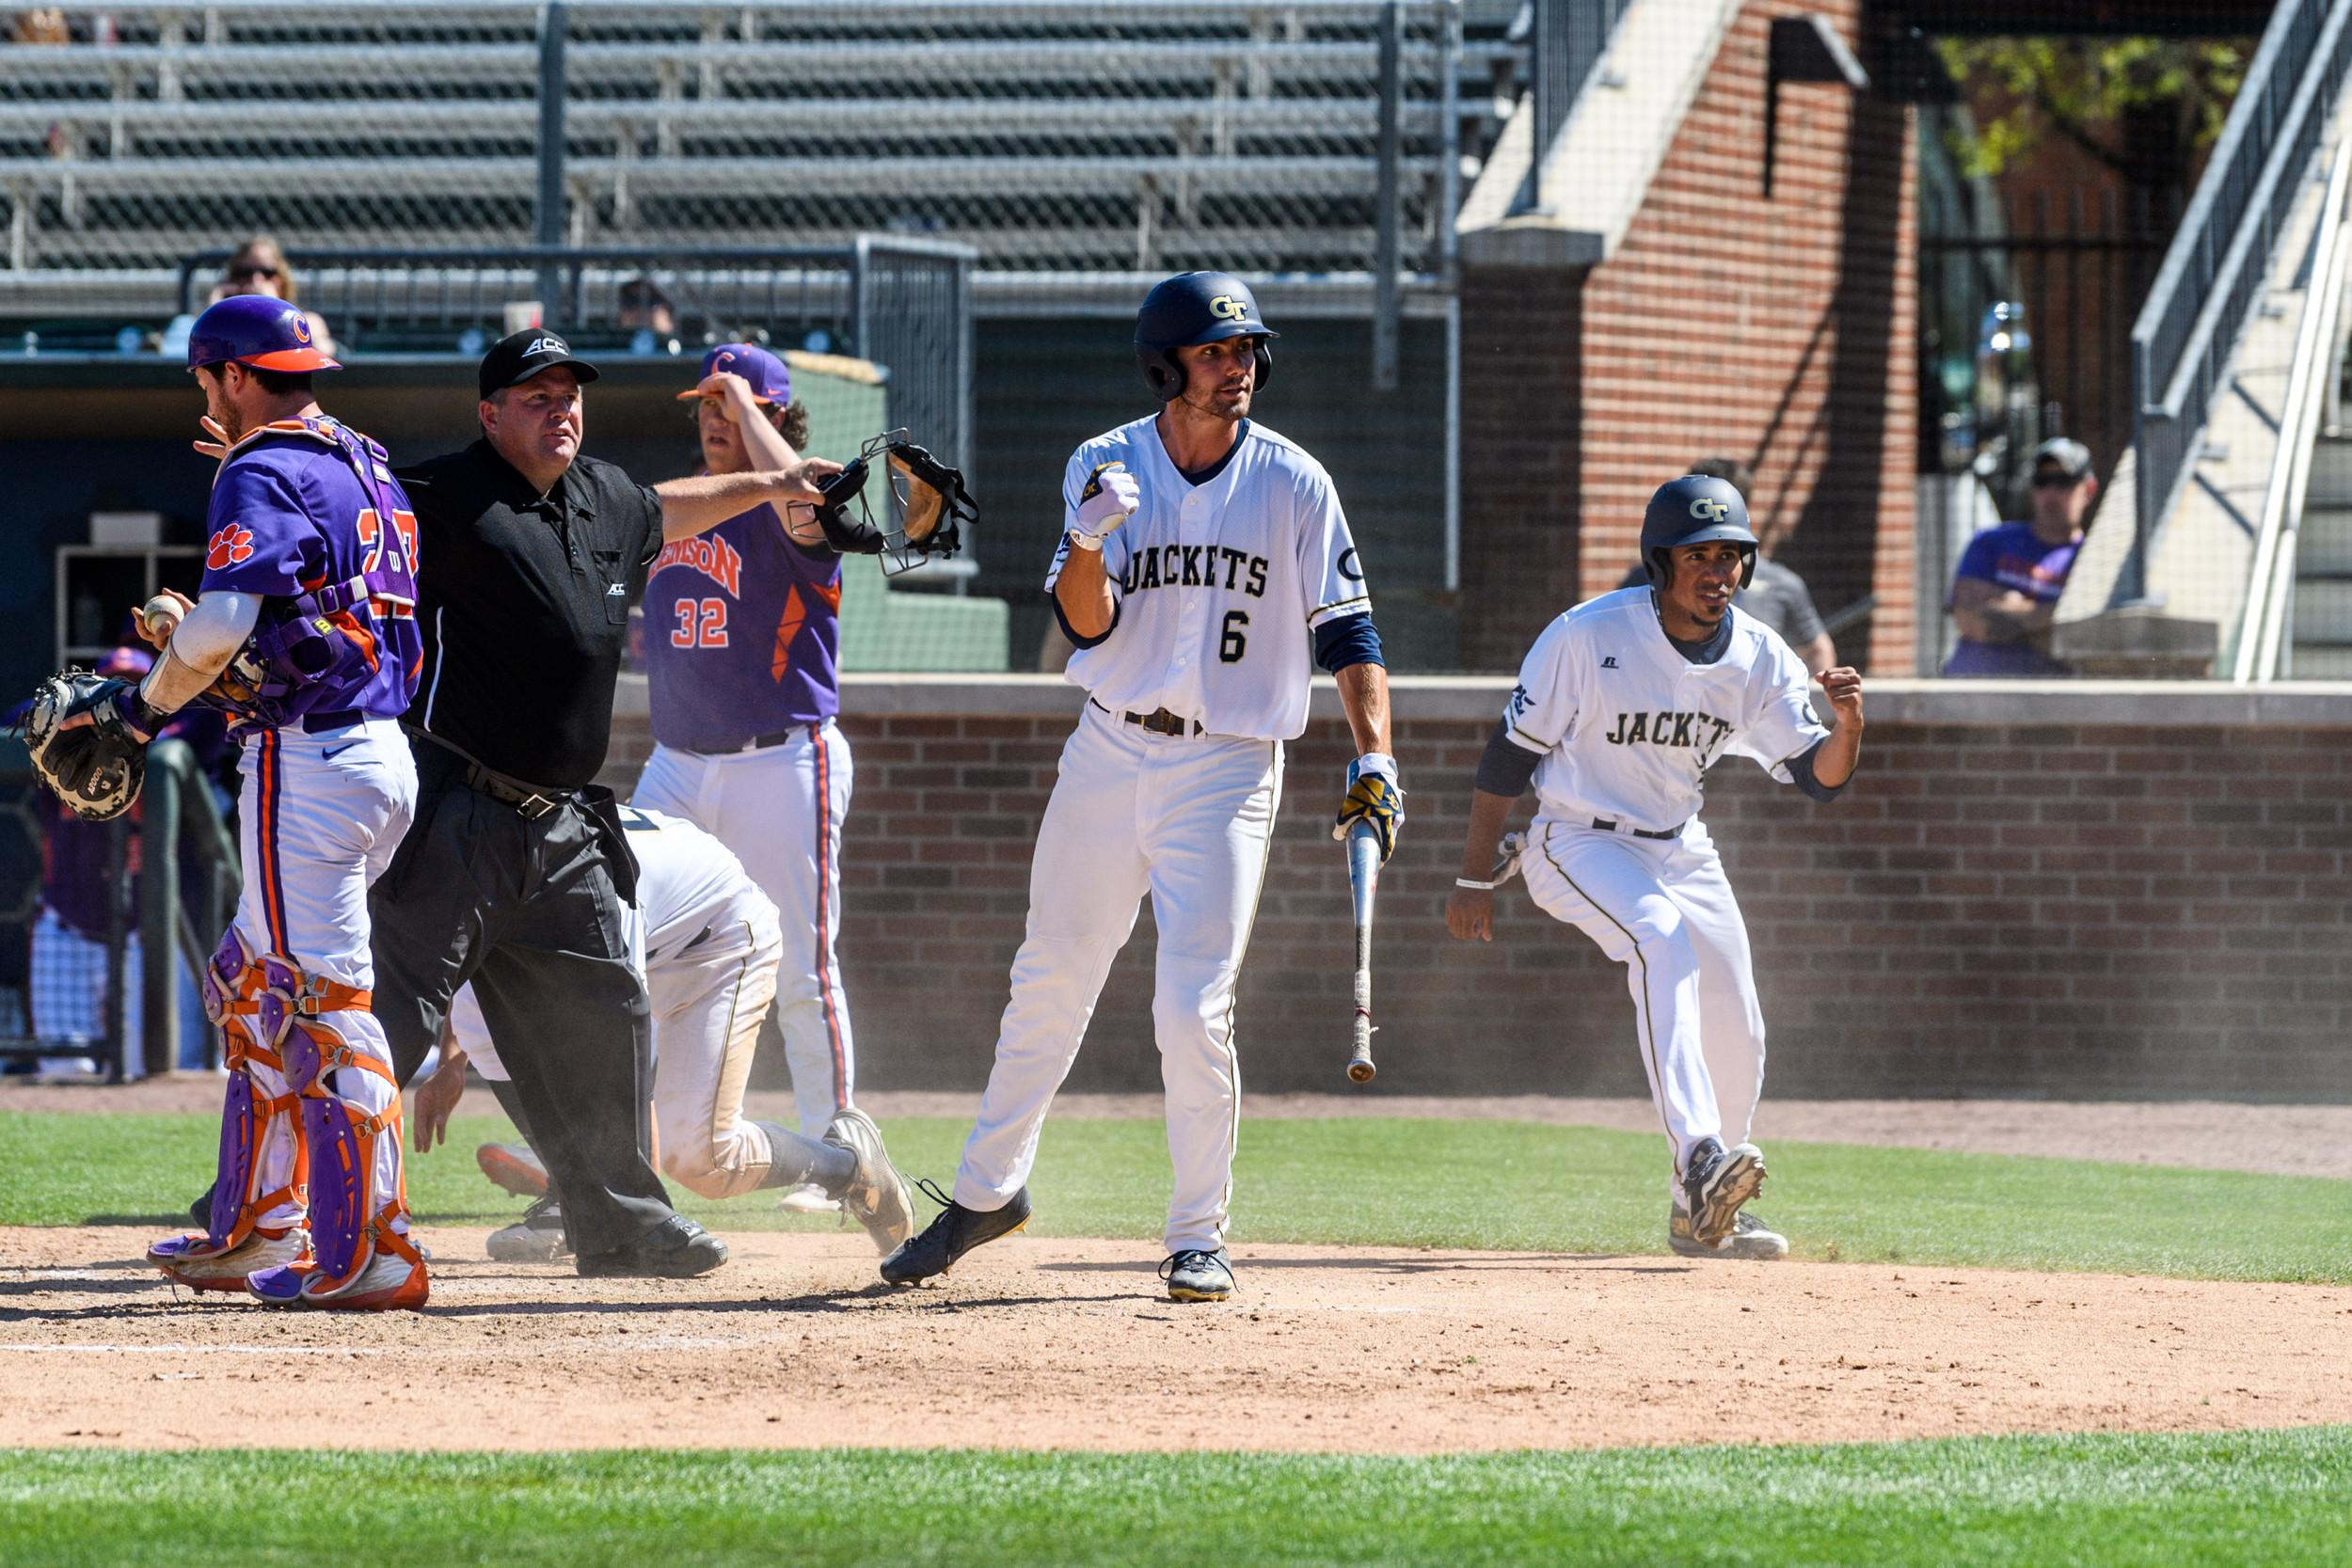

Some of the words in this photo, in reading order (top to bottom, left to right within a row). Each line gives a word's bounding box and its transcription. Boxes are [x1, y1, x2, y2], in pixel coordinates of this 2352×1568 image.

[1209, 294, 1248, 321] GT
[294, 314, 310, 343] C
[520, 337, 569, 358] ACC
[1689, 498, 1729, 522] GT
[1123, 544, 1270, 599] JACKETS
[670, 597, 729, 648] 32
[1218, 610, 1251, 664] 6
[1605, 711, 1736, 754] JACKET
[87, 767, 103, 796] A2000
